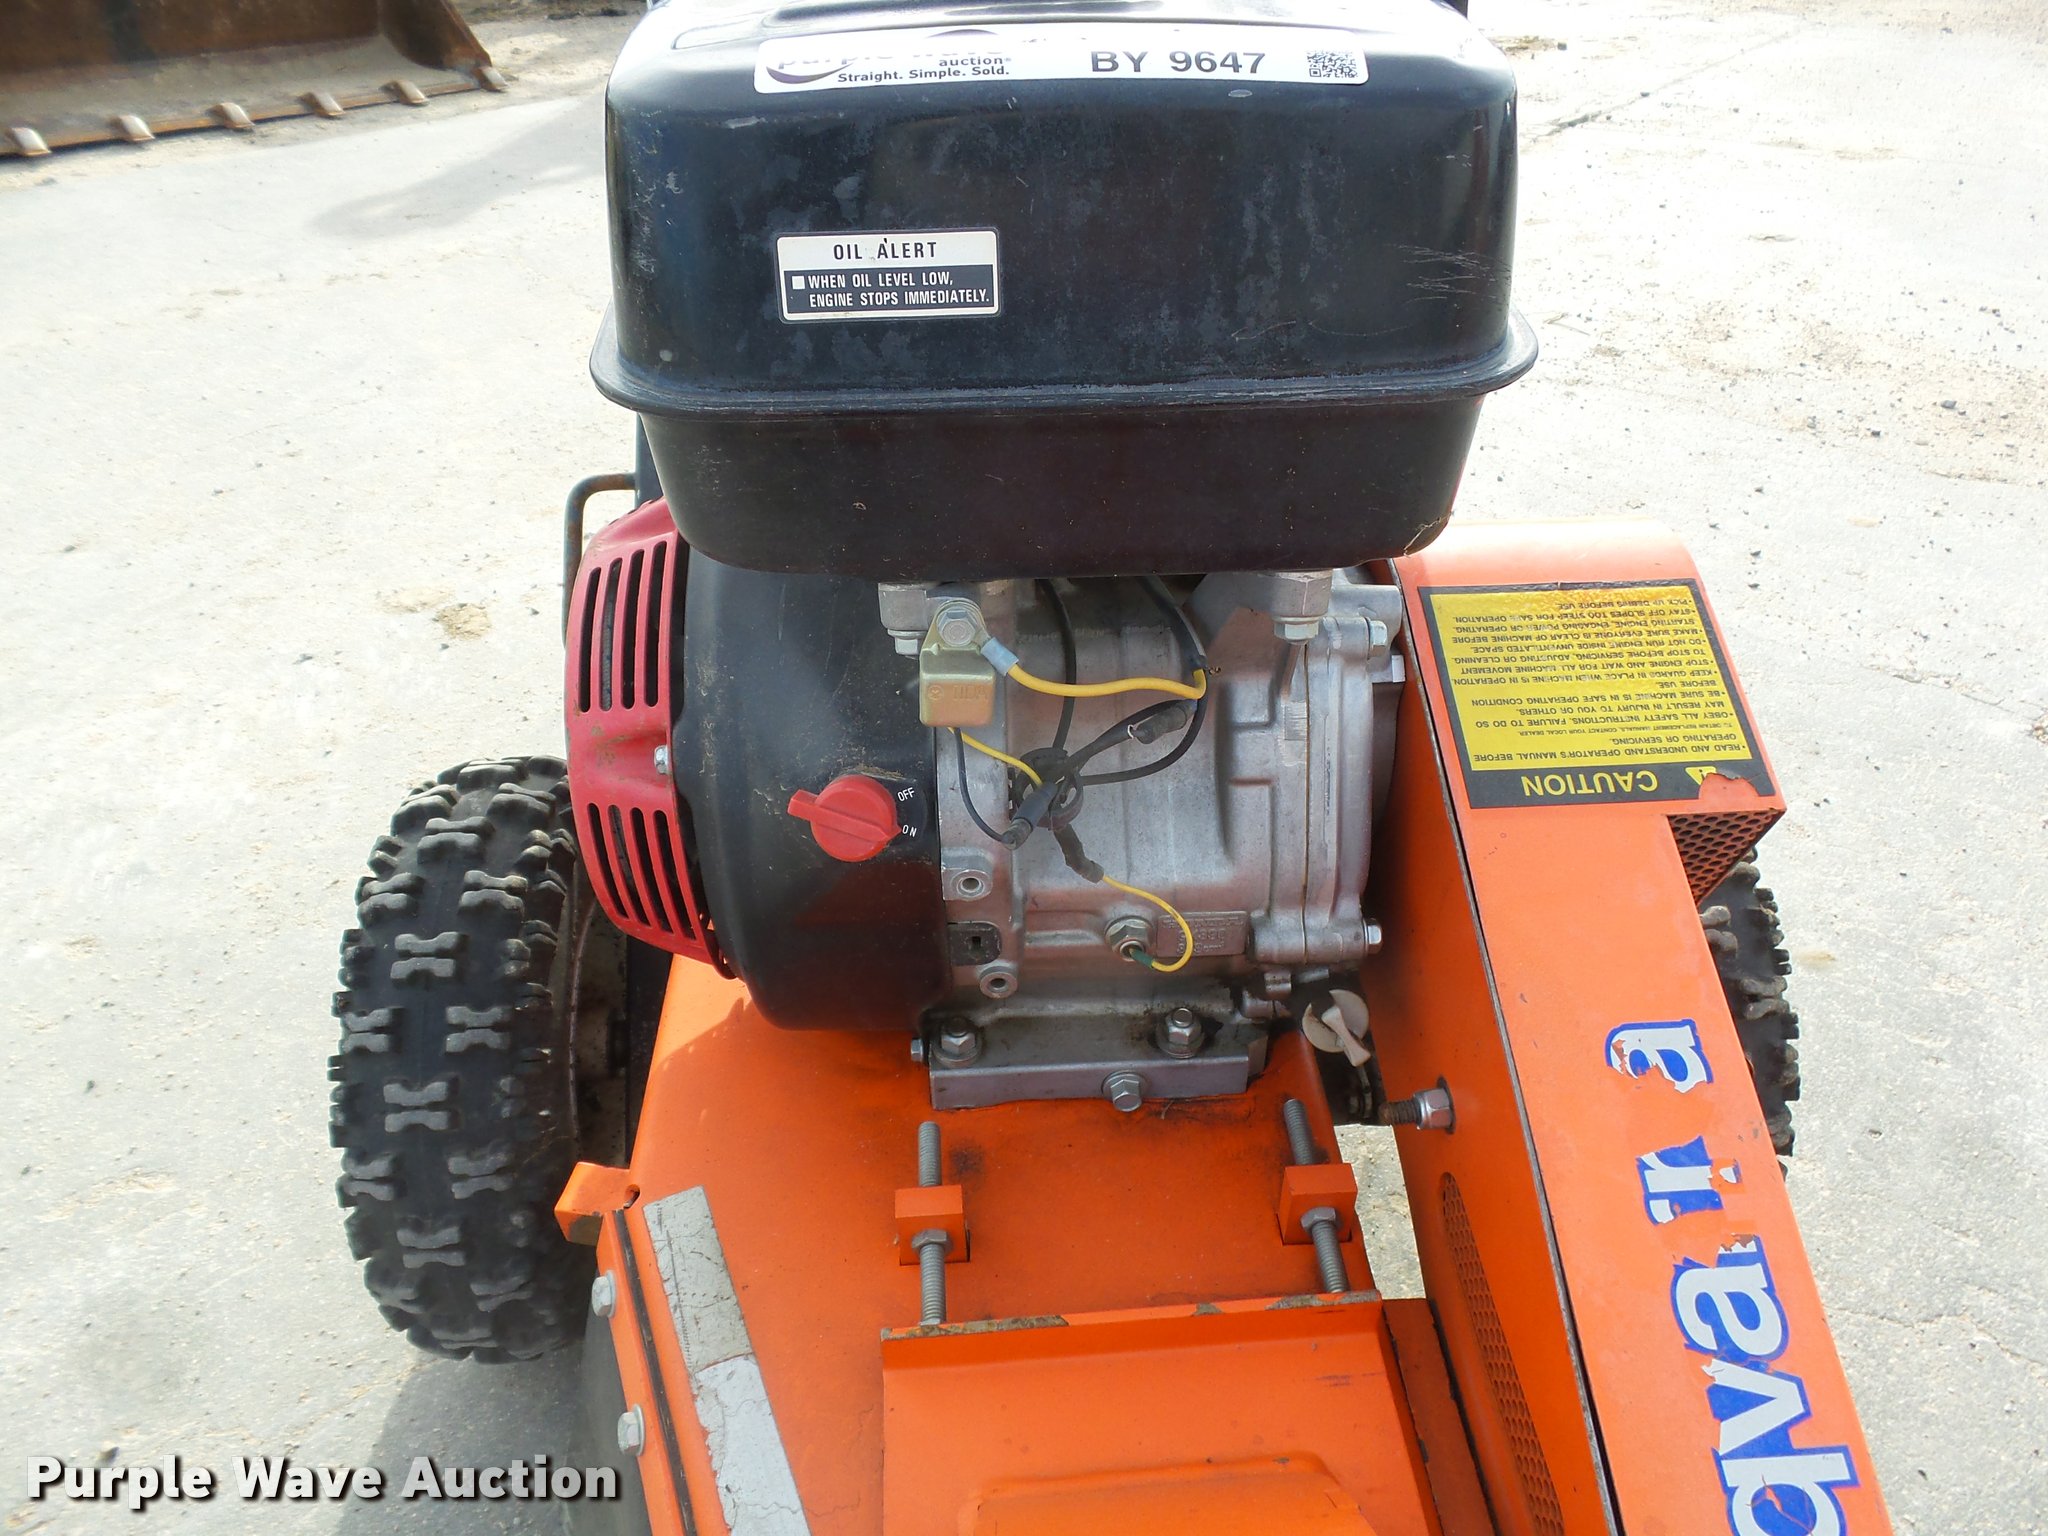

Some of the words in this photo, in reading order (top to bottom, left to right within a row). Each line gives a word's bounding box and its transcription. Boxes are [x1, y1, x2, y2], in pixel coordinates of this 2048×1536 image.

[1090, 50, 1150, 73] BY
[1168, 50, 1266, 75] 9647
[837, 71, 903, 83] Straight.
[908, 68, 966, 80] Simple.
[971, 65, 1010, 76] Sold.
[833, 244, 863, 260] OIL
[876, 241, 937, 259] ALERT
[807, 274, 846, 289] WHEN
[852, 273, 872, 288] OIL
[878, 271, 916, 287] LEVEL
[921, 271, 954, 286] LOW,
[809, 292, 854, 308] ENGINE
[860, 291, 899, 306] STOPS
[904, 288, 990, 305] IMMEDIATELY.
[1578, 601, 1614, 611] BEFORE
[1557, 612, 1586, 621] STEEP
[1588, 612, 1606, 620] TOO
[1609, 610, 1645, 619] SLOPES
[1648, 609, 1665, 617] OFF
[1668, 608, 1691, 616] STAY
[1509, 614, 1533, 623] SA
[1536, 613, 1554, 622] FOR
[1562, 621, 1609, 631] ENGAGING
[1650, 618, 1695, 627] STARTING
[1550, 632, 1580, 641] CLEAR
[1594, 630, 1643, 639] EVERYONE
[1646, 629, 1670, 637] SURE
[1672, 628, 1698, 636] MAKE
[1452, 636, 1488, 644] BEFORE
[1491, 634, 1532, 643] MACHINE
[1535, 634, 1548, 642] OF
[1689, 638, 1701, 646] DO
[1577, 641, 1605, 651] INSIDE
[1609, 640, 1643, 649] ENGINE
[1645, 640, 1665, 648] RUN
[1667, 639, 1684, 647] NOT
[1627, 650, 1664, 659] BEFORE
[1667, 649, 1690, 657] STOP
[1693, 648, 1706, 656] TO
[1503, 655, 1517, 663] OR
[1685, 658, 1709, 667] STOP
[1560, 664, 1576, 672] ALL
[1578, 663, 1597, 672] FOR
[1601, 662, 1623, 670] WAIT
[1626, 661, 1646, 669] AND
[1649, 660, 1682, 668] ENGINE
[1460, 666, 1512, 675] MOVEMENT
[1515, 665, 1557, 674] MACHINE
[1689, 669, 1713, 677] KEEP
[1509, 677, 1518, 685] IN
[1521, 676, 1530, 684] IS
[1604, 672, 1635, 681] PLACE
[1680, 679, 1717, 688] BEFORE
[1679, 691, 1704, 699] SURE
[1707, 690, 1721, 698] BE
[1471, 697, 1523, 706] CONDITION
[1526, 696, 1579, 705] OPERATING
[1582, 695, 1606, 703] SAFE
[1617, 704, 1649, 712] INJURY
[1666, 702, 1701, 710] RESULT
[1704, 700, 1725, 708] MAY
[1577, 706, 1596, 714] YOU
[1600, 705, 1613, 713] TO
[1643, 713, 1679, 722] SAFETY
[1681, 712, 1699, 720] ALL
[1703, 711, 1728, 719] OBEY
[1492, 720, 1507, 728] DO
[1510, 719, 1524, 727] TO
[1526, 718, 1566, 727] FAILURE
[1666, 735, 1679, 743] OR
[1683, 733, 1736, 742] OPERATING
[1624, 746, 1686, 755] UNDERSTAND
[1691, 745, 1710, 753] AND
[1714, 744, 1740, 752] READ
[1473, 753, 1513, 762] BEFORE
[1516, 752, 1556, 761] MANUAL
[1560, 749, 1620, 759] OPERATOR'S
[1521, 770, 1658, 796] CAUTION
[897, 787, 915, 802] OFF
[902, 824, 917, 838] ON
